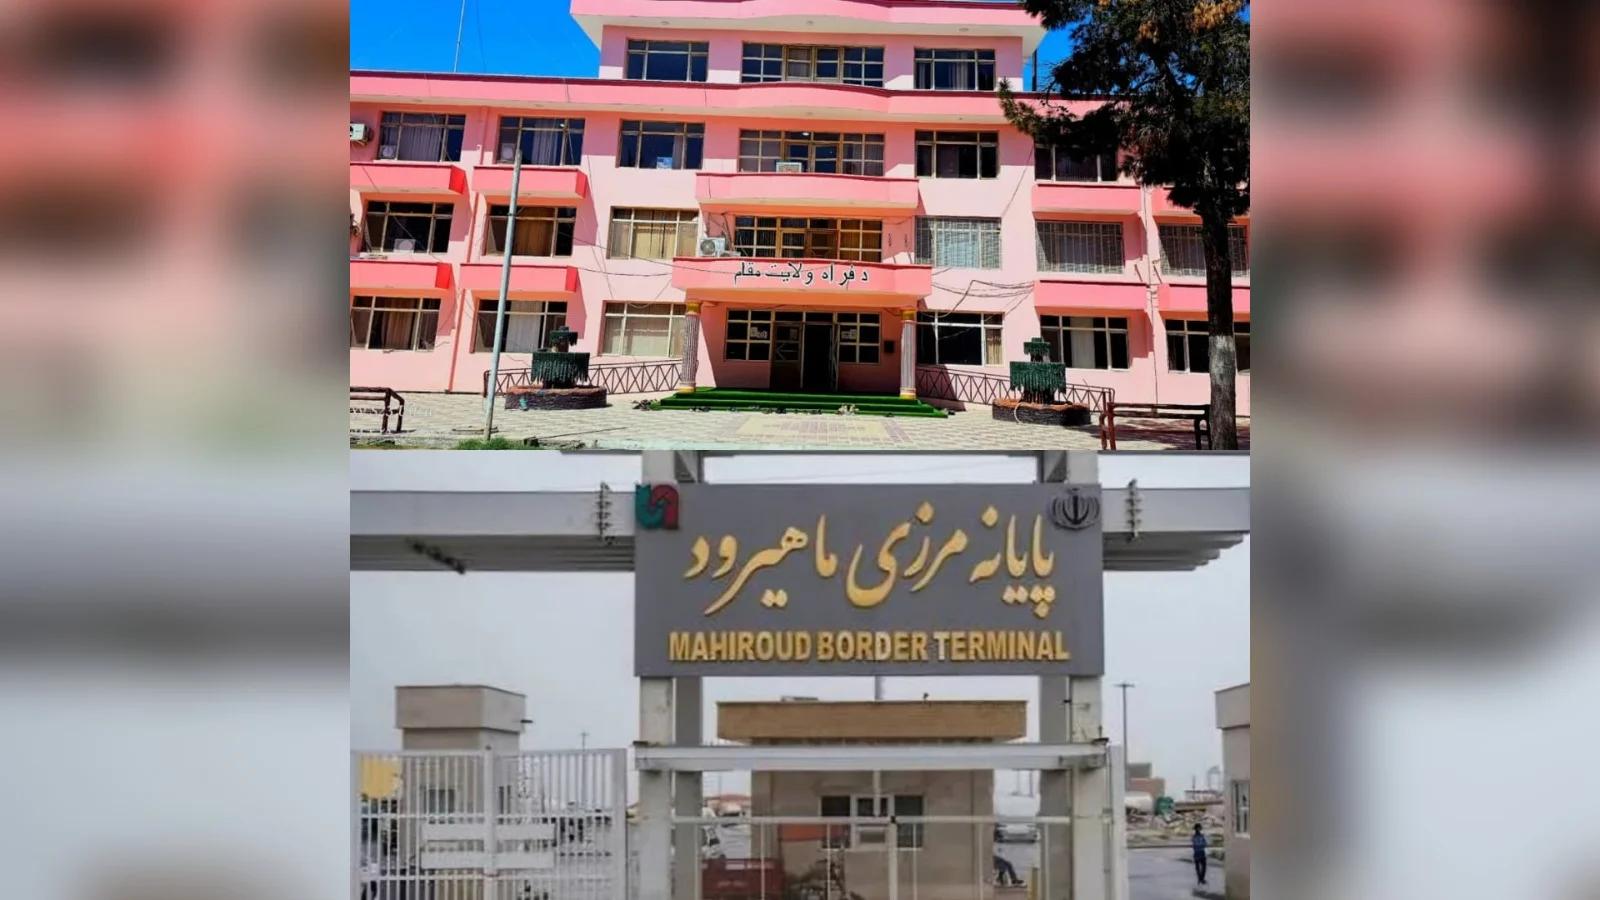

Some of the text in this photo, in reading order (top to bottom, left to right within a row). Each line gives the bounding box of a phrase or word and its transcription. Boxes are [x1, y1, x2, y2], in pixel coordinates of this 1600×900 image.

[734, 261, 761, 286] مقام
[861, 271, 868, 281] د
[684, 501, 1056, 618] پایانه مرزی ماهیرود
[668, 630, 1072, 662] MAHIROUD BORDER TERMINAL
